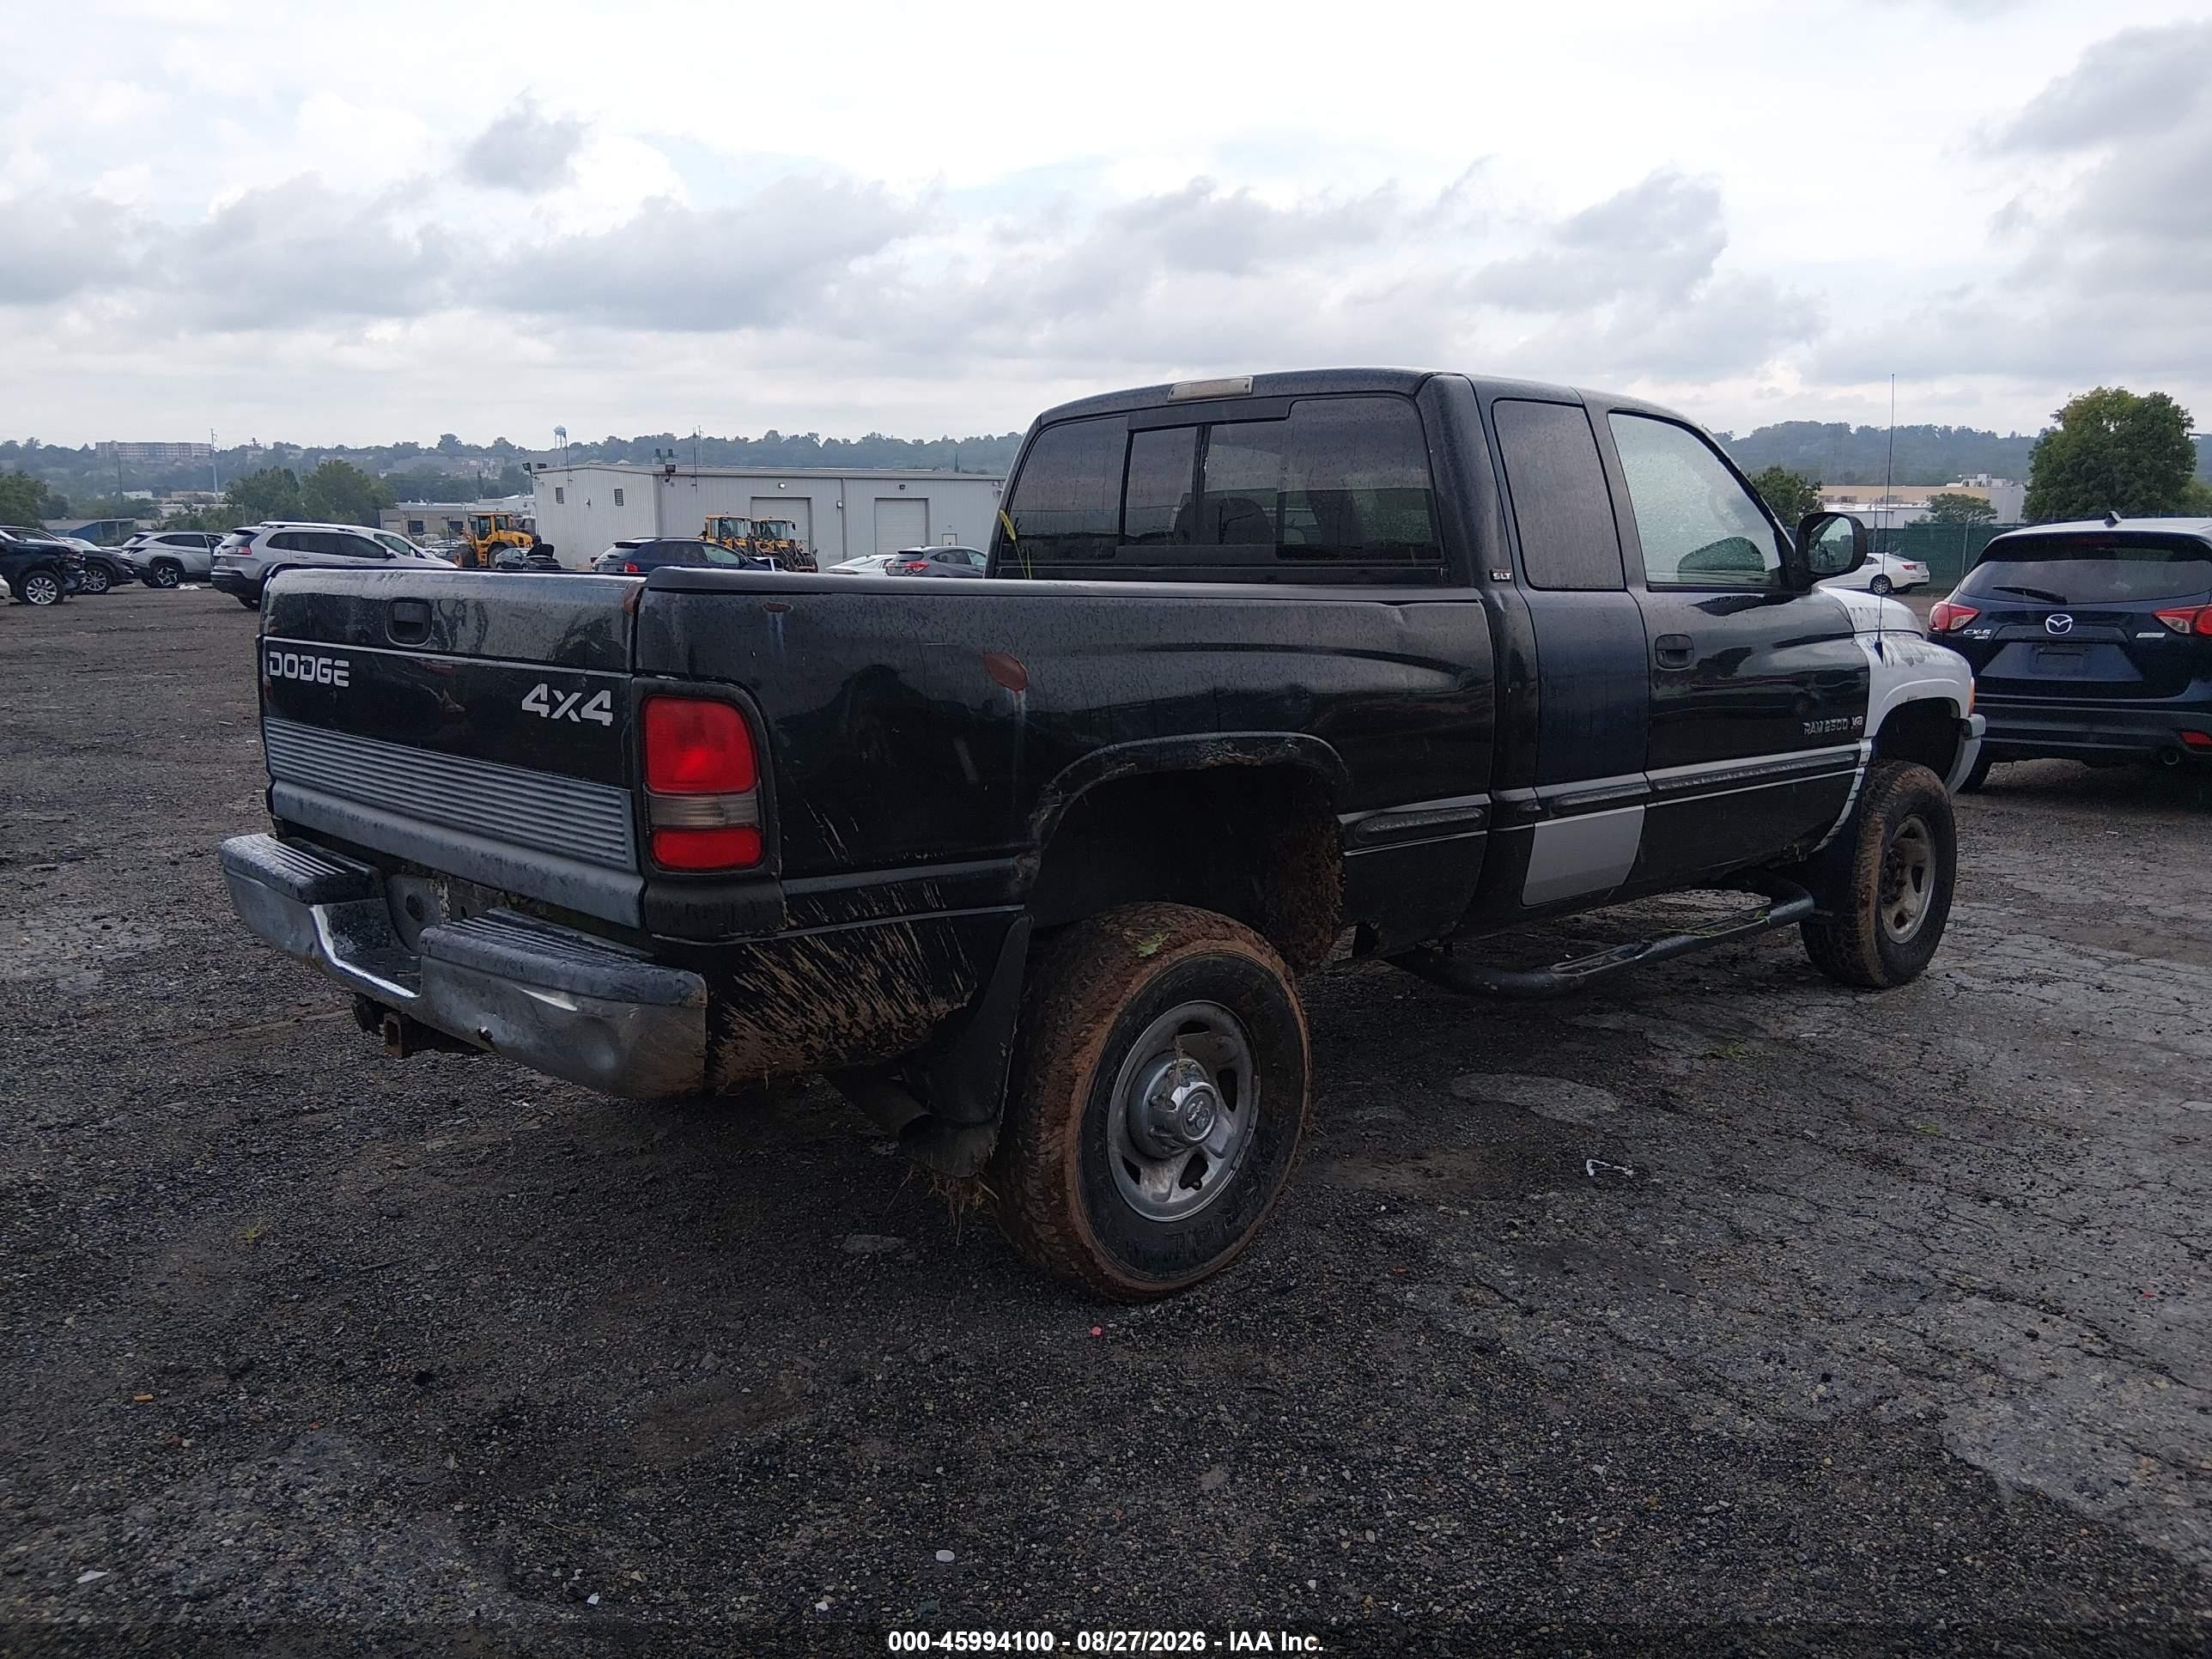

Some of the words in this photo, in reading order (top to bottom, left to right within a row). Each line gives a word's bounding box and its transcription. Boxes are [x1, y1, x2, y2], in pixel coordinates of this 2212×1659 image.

[1492, 572, 1511, 580] SLT
[269, 651, 349, 687] DODGE
[1802, 720, 1823, 735] RAM
[1825, 718, 1848, 732] 2500
